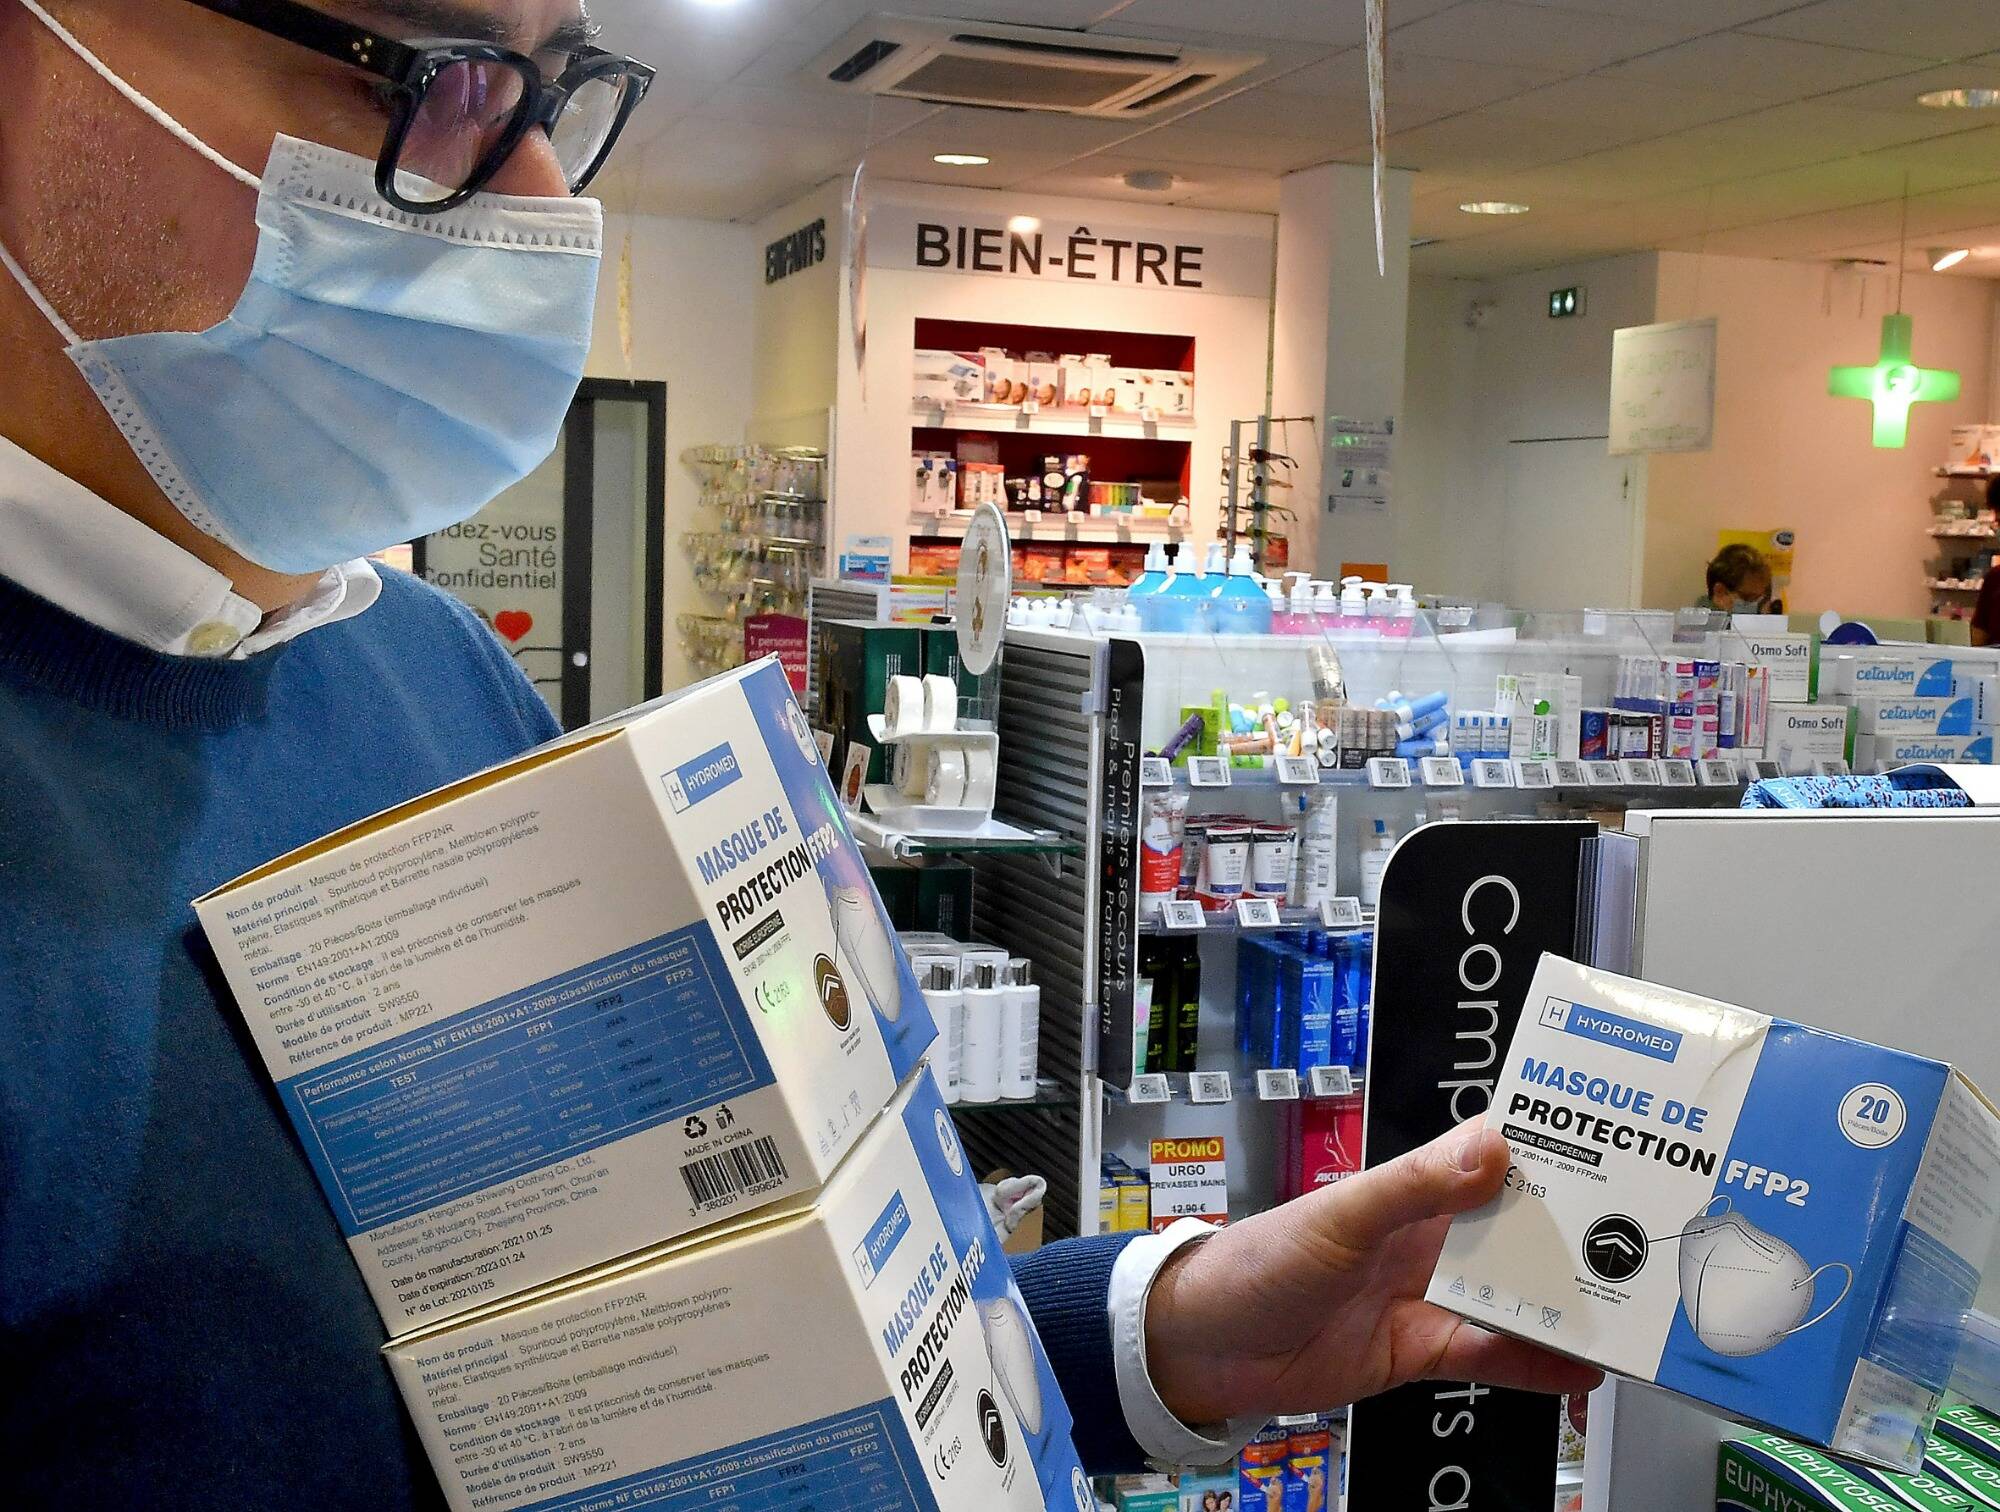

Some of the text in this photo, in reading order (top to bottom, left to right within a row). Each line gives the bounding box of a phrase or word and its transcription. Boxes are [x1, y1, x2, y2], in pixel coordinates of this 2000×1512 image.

[915, 223, 1205, 288] BIEN-ÊTRE
[479, 542, 557, 568] Santé
[1751, 643, 1807, 657] Osmo Soft
[1109, 688, 1121, 751] Pieds
[1788, 716, 1844, 729] Osmo Soft
[685, 752, 737, 791] HYDROMED
[694, 801, 789, 889] MASQUE DE
[1105, 784, 1117, 855] mains
[225, 822, 455, 920] Nom de produit Masque de protection FFP2NR
[716, 819, 840, 930] PROTECTION FFP2
[1116, 742, 1135, 992] Premiers secours
[248, 951, 302, 977] Emballage
[307, 941, 322, 954] 20
[262, 983, 312, 1006] Condition
[312, 976, 327, 988] de
[327, 958, 374, 982] stockage
[454, 921, 469, 933] de
[469, 902, 517, 927] conserver
[536, 877, 581, 901] masques
[255, 973, 289, 992] Norme
[274, 980, 401, 1034] Durée d'utilisation 2 ans
[280, 989, 419, 1049] Modèle de produit SW9550
[287, 1002, 433, 1065] Référence de produit MP221
[303, 946, 689, 1097] Performance selon Norme NF du masque
[388, 1070, 417, 1088] TEST
[525, 1019, 553, 1038] FFP1
[664, 966, 694, 985] FFP3
[1576, 1014, 1673, 1052] HYDROMED
[1518, 1055, 1710, 1136] MASQUE DE
[1854, 1092, 1892, 1126] 20
[682, 1127, 754, 1158] MADE IN CHINA
[1151, 1140, 1220, 1159] PROMO
[1503, 1126, 1537, 1144] NORME
[1535, 1134, 1598, 1165] EUROPÉENNE
[1507, 1091, 1812, 1208] PROTECTION FFP2
[687, 1176, 783, 1217] 3 380201 599624
[1151, 1178, 1226, 1190] CREVASSES MAINS
[1168, 1164, 1206, 1177] URGO
[1515, 1178, 1548, 1200] 2163
[1575, 1165, 1609, 1183] FFP2NR
[869, 1200, 907, 1259] HYDROMED
[390, 1275, 414, 1289] Date
[413, 1270, 427, 1281] de
[500, 1223, 553, 1249] 2021.01.25
[397, 1289, 421, 1303] Date
[474, 1250, 525, 1276] 2023.01.24
[418, 1302, 432, 1312] de
[448, 1278, 495, 1301] 20210125
[882, 1239, 950, 1357] MASQUE DE
[1578, 1285, 1593, 1296] plus
[1617, 1290, 1632, 1300] pour
[900, 1274, 968, 1401] PROTECTION
[957, 1235, 986, 1290] FFP2
[707, 1483, 736, 1499] FFP1
[848, 1440, 878, 1457] FFP3
[946, 1435, 962, 1464] 2163
[470, 1458, 617, 1509] Référence de produit MP221
